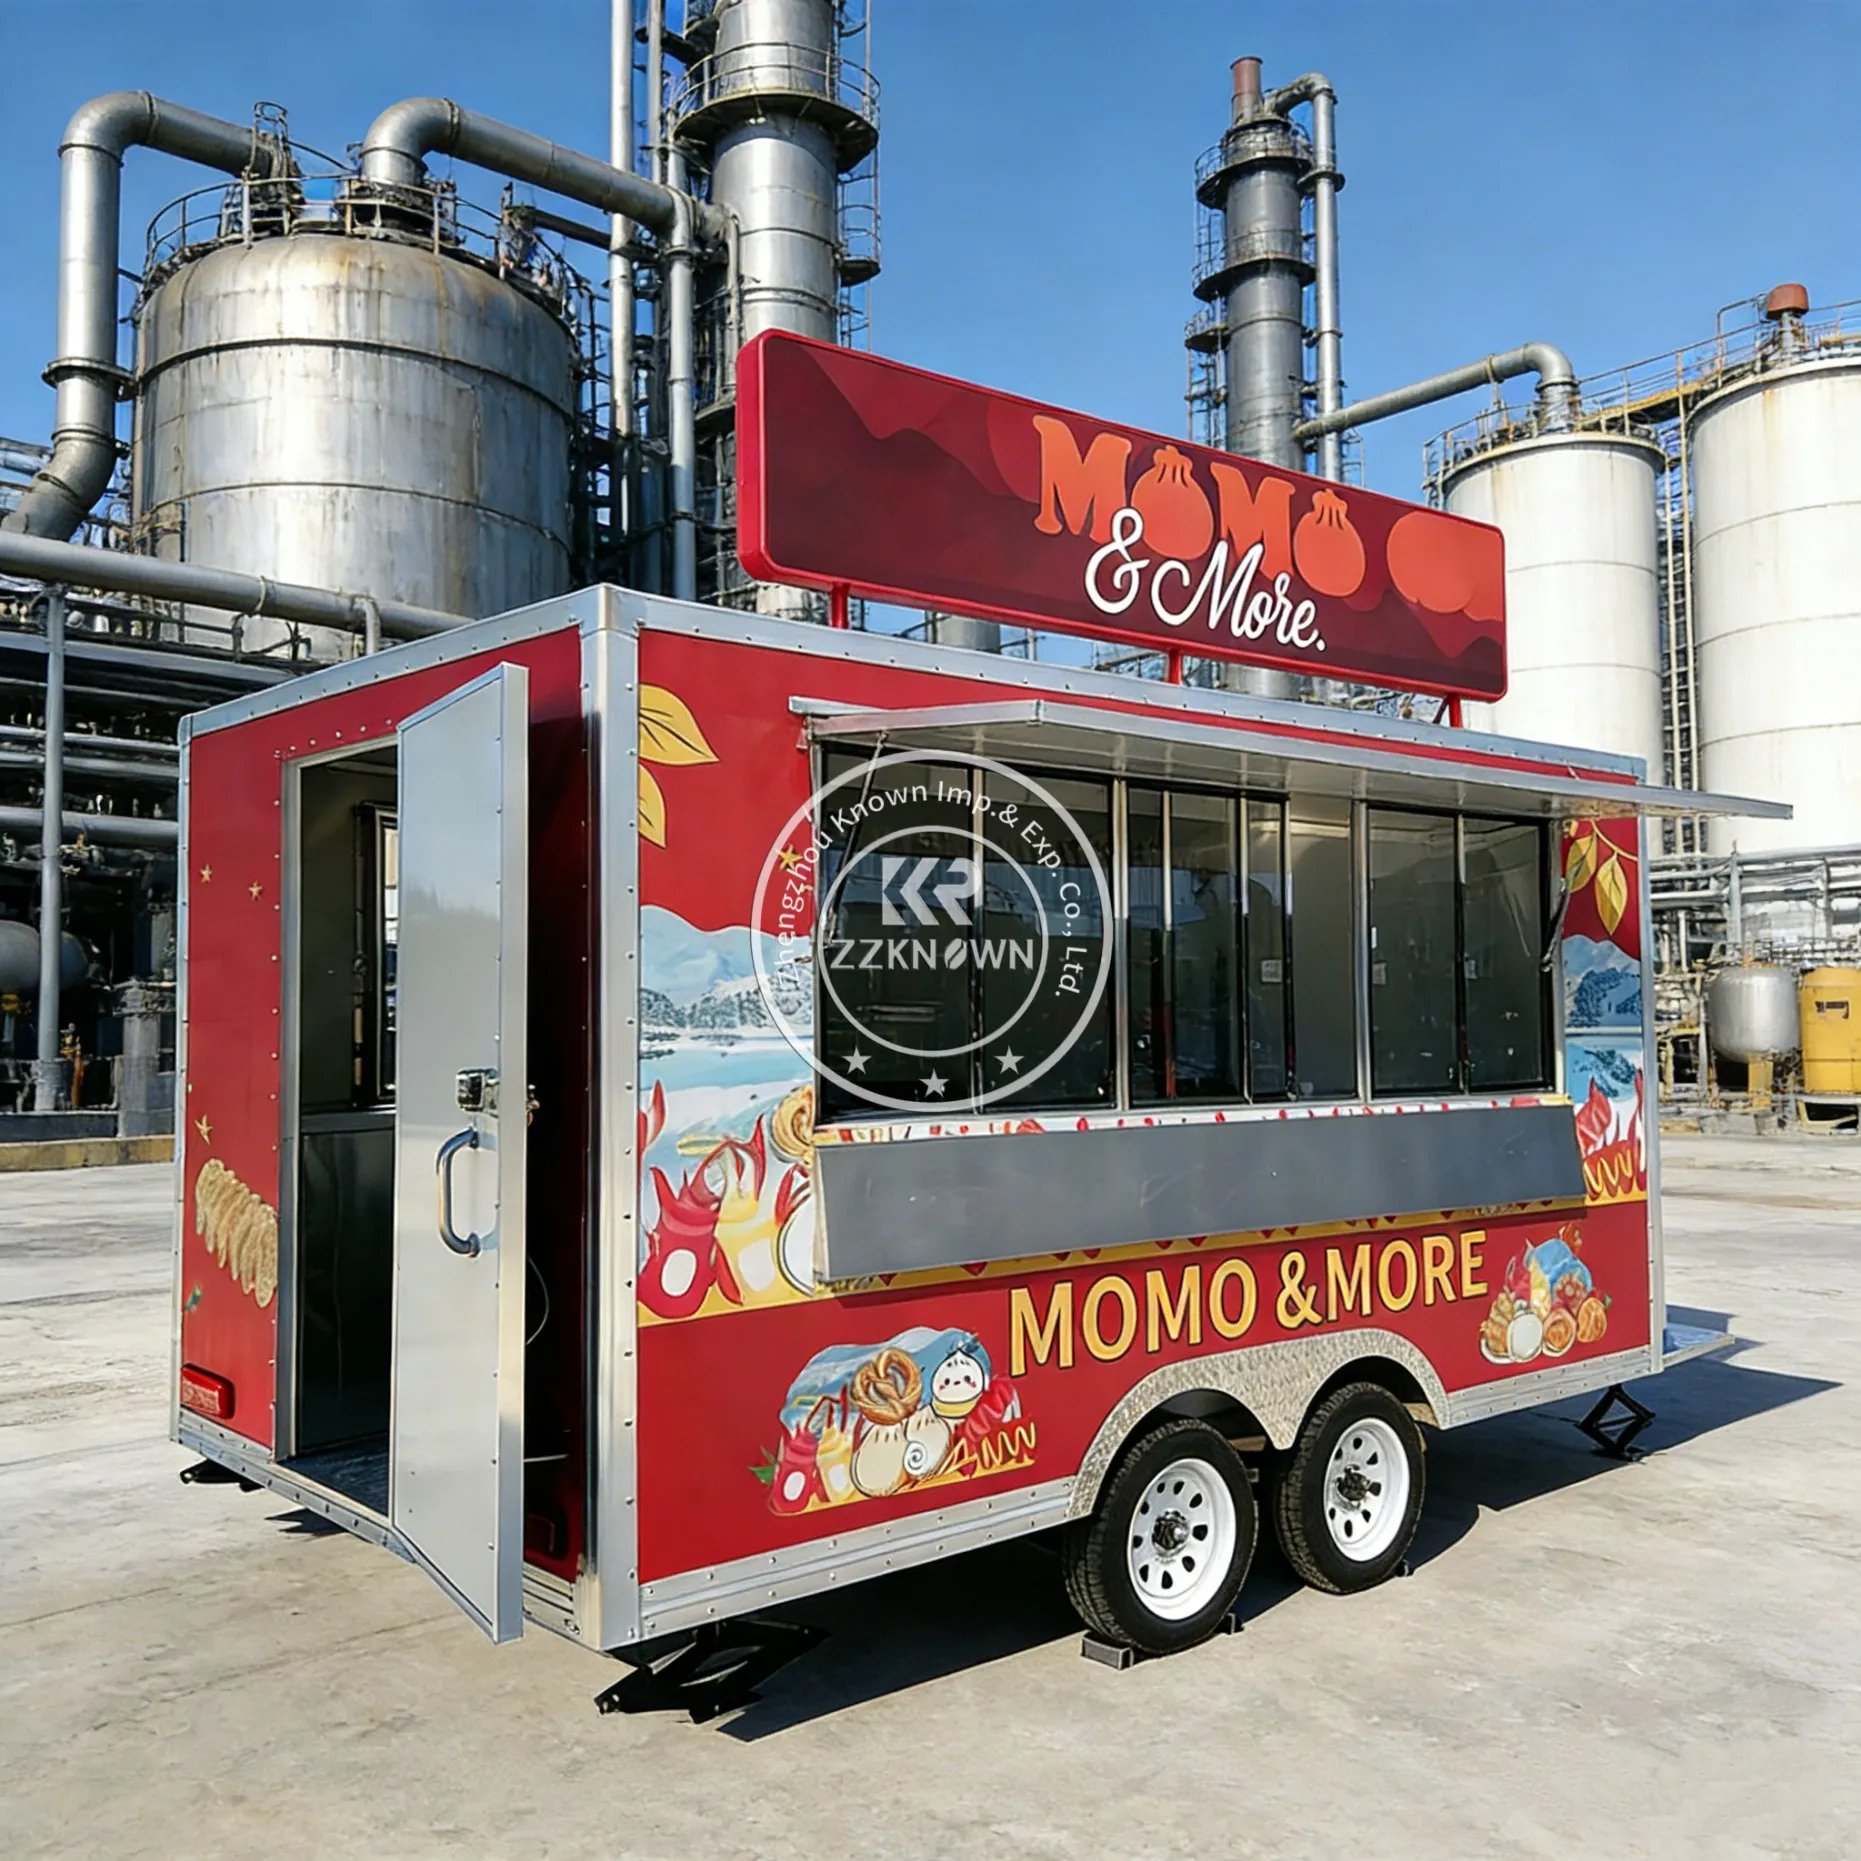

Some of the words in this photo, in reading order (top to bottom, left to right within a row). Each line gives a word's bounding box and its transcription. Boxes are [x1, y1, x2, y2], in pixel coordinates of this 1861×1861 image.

[1032, 413, 1367, 597] MOMO
[1085, 507, 1150, 615] &
[1151, 539, 1326, 652] More.
[1009, 1257, 1258, 1377] MOMO
